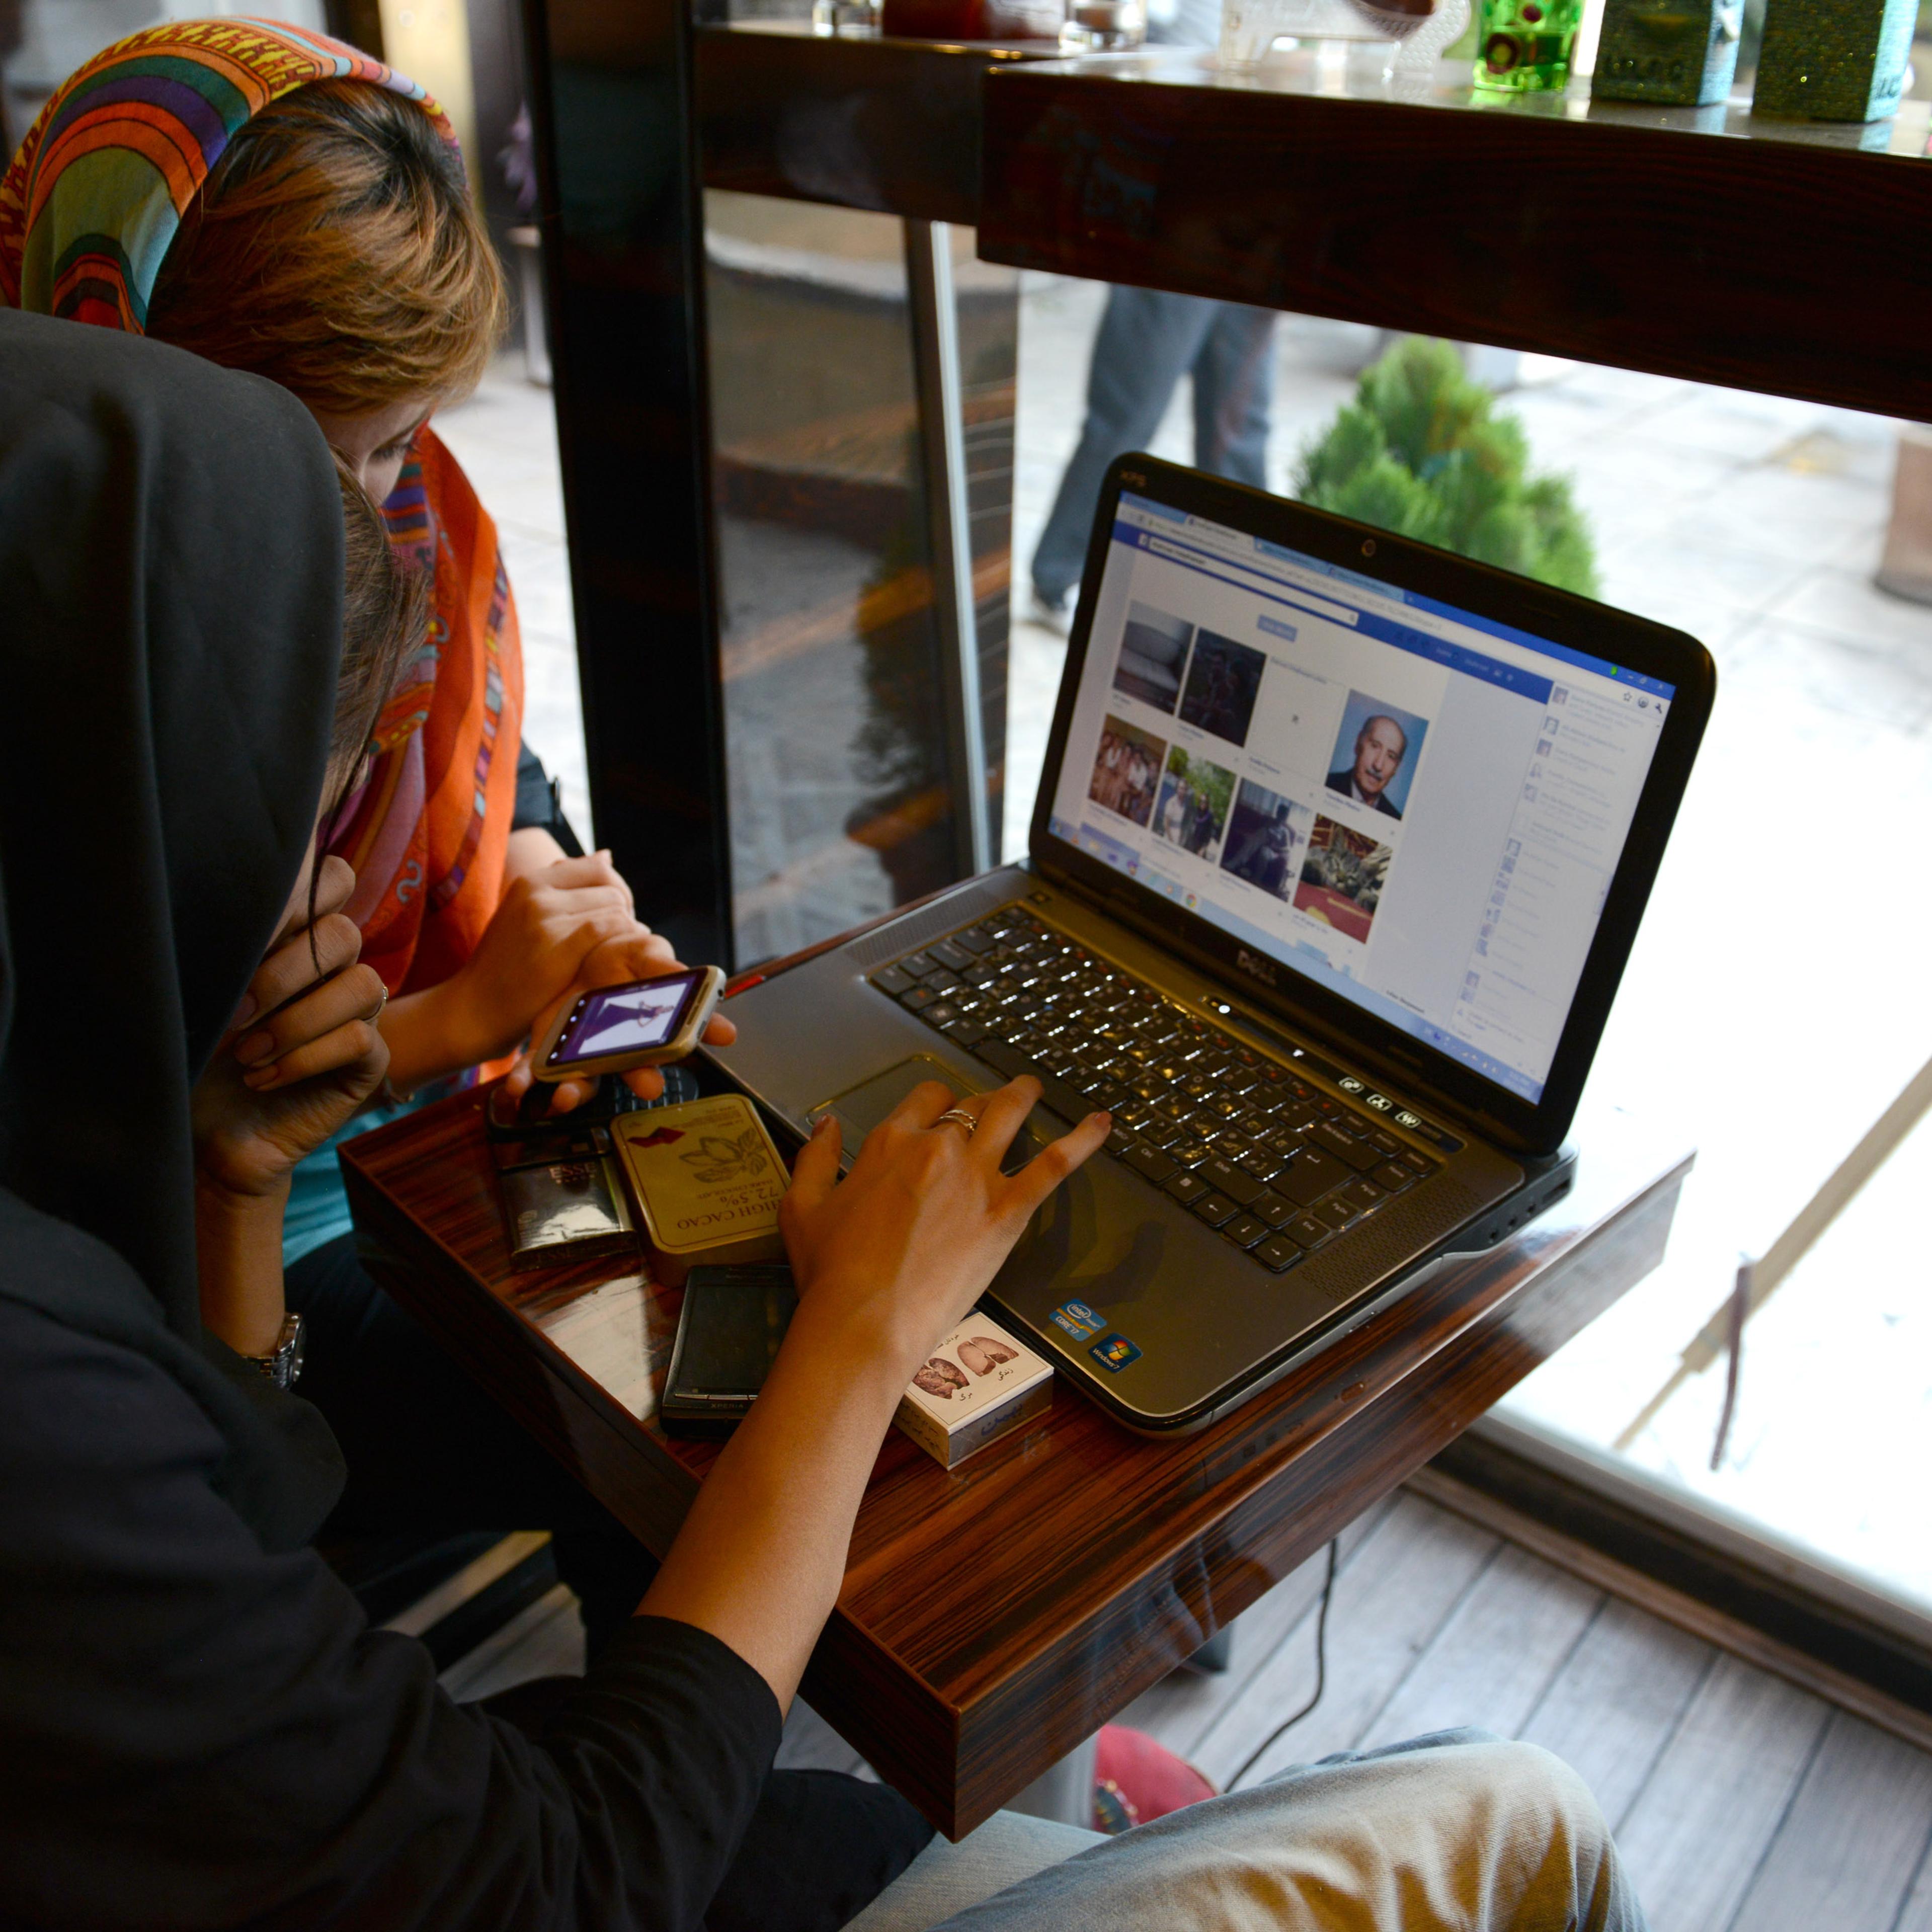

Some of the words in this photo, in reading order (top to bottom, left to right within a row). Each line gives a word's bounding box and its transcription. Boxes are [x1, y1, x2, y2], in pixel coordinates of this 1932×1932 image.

[549, 1161, 597, 1179] ESSE
[719, 1188, 779, 1206] 72.5%
[739, 1198, 780, 1217] HIGH
[677, 1210, 735, 1230] CACAO
[1071, 1305, 1088, 1318] intel
[1055, 1316, 1071, 1329] CORE
[1092, 1348, 1115, 1367] Windows
[998, 1367, 1014, 1381] زندگی
[959, 1392, 973, 1402] مرگ
